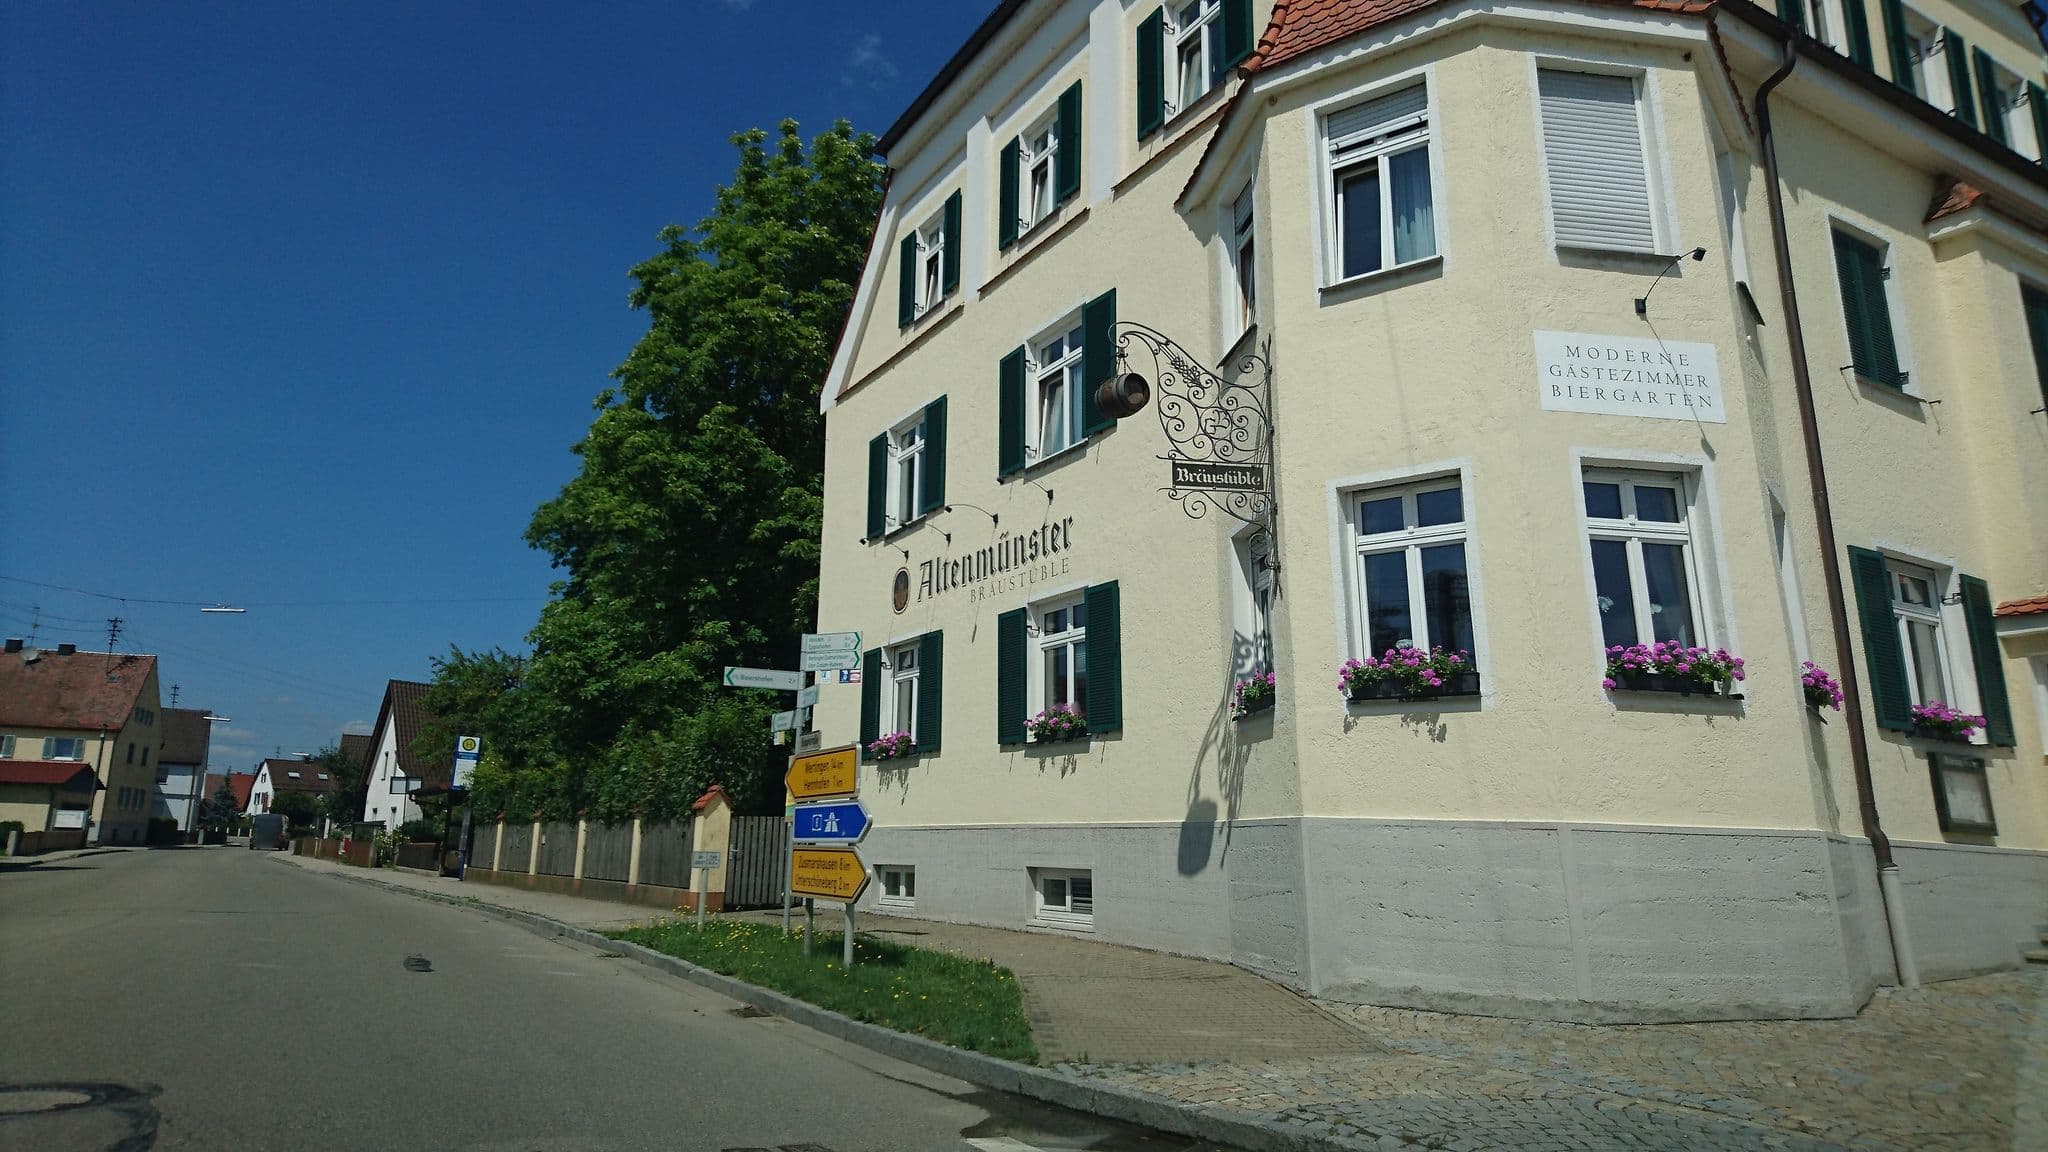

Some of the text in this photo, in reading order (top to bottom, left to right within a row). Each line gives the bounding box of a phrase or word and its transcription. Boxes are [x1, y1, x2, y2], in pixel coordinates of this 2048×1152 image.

[1566, 345, 1690, 366] MODERNE
[1549, 363, 1710, 388] GÄSTEZIMMER
[1552, 384, 1713, 408] BIERGARTEN
[1176, 468, 1261, 486] Bräustüble
[917, 515, 1074, 603] Altenmünster
